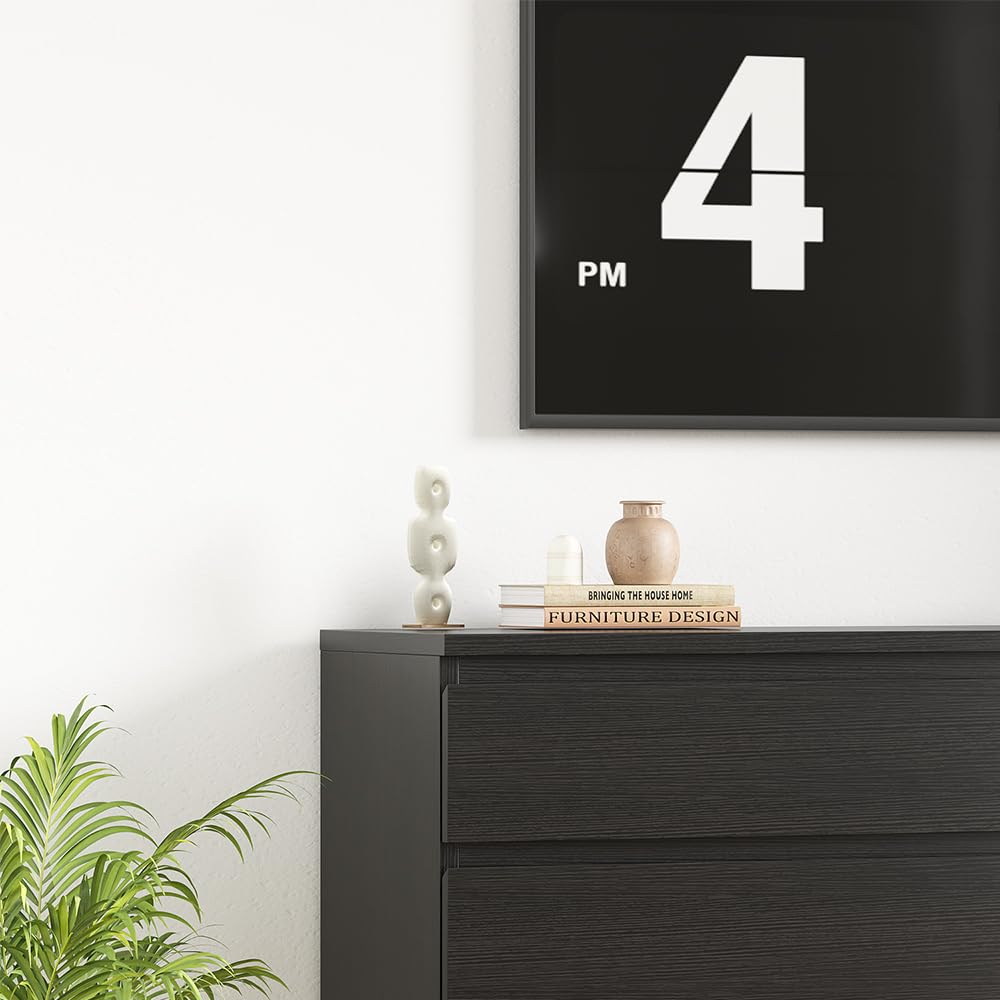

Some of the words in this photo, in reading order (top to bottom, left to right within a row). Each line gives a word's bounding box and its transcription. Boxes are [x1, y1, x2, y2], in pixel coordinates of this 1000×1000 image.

[661, 55, 824, 291] 4
[578, 261, 627, 288] PM
[588, 590, 626, 601] BRINGING
[628, 590, 643, 601] THE
[644, 590, 670, 601] HOUSE
[672, 590, 693, 601] HOME
[548, 611, 663, 624] FURNITURE
[669, 610, 740, 623] DESIGN
